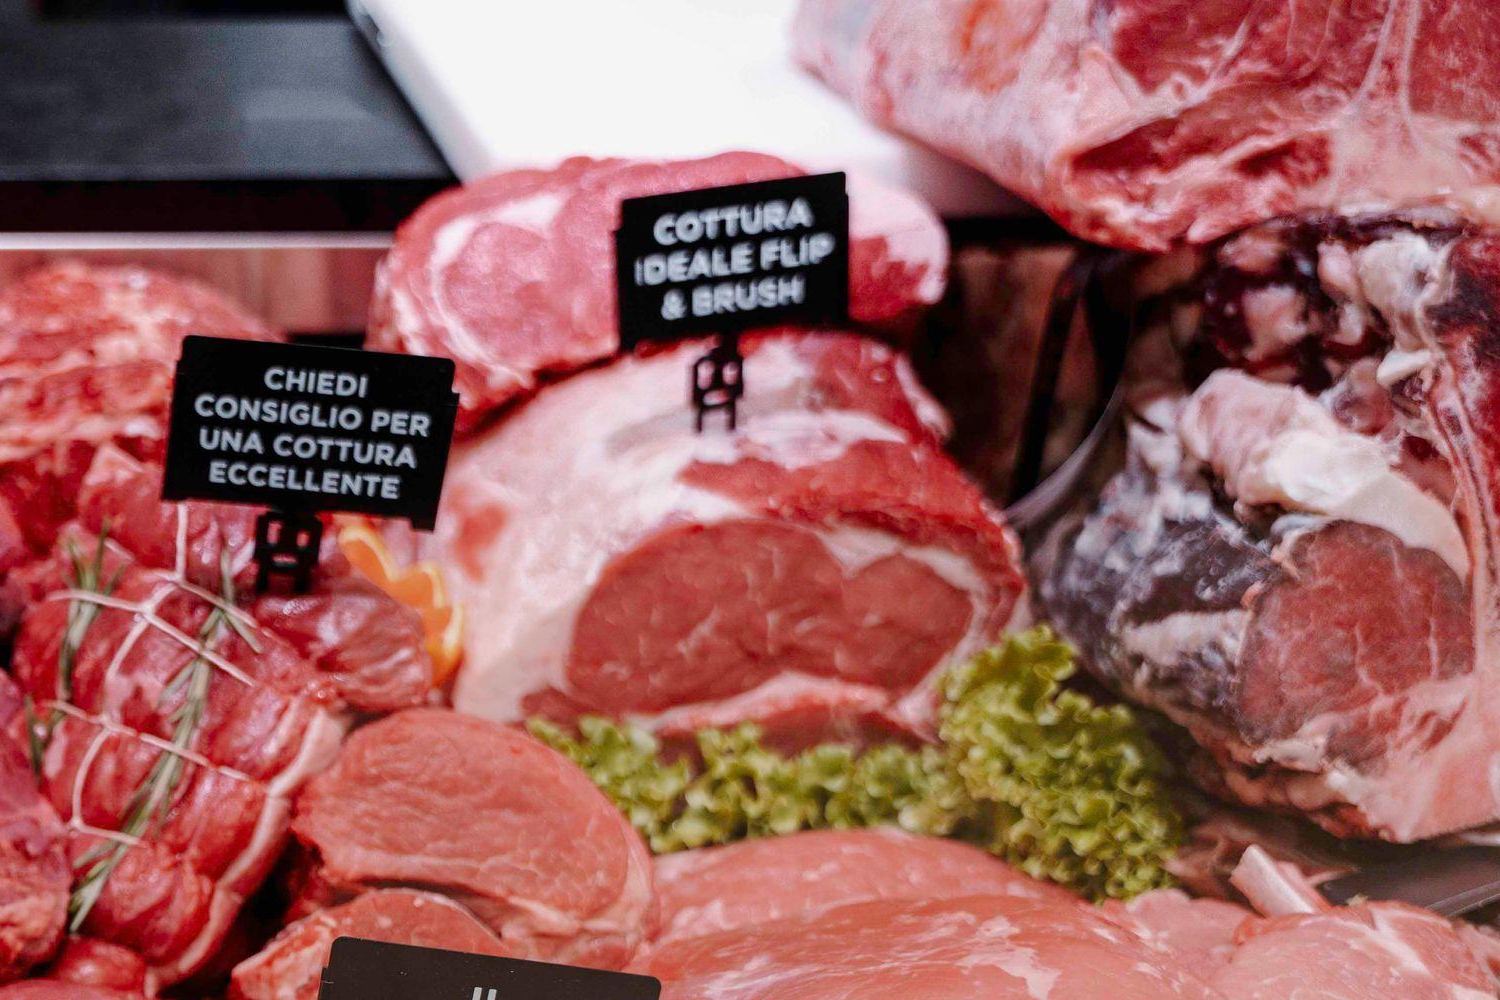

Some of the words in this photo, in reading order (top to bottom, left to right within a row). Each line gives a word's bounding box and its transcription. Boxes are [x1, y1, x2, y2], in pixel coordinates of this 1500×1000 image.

[653, 199, 812, 246] COTTURA
[634, 243, 753, 286] IDEALE
[760, 233, 833, 270] FLIP
[661, 291, 686, 320] &
[692, 275, 804, 316] BRUSH
[264, 367, 368, 398] CHIEDI
[194, 394, 362, 430] CONSIGLIO
[370, 410, 430, 437] PER
[199, 428, 263, 454] UNA
[273, 435, 416, 469] COTTURA
[209, 461, 400, 500] ECCELLENTE
